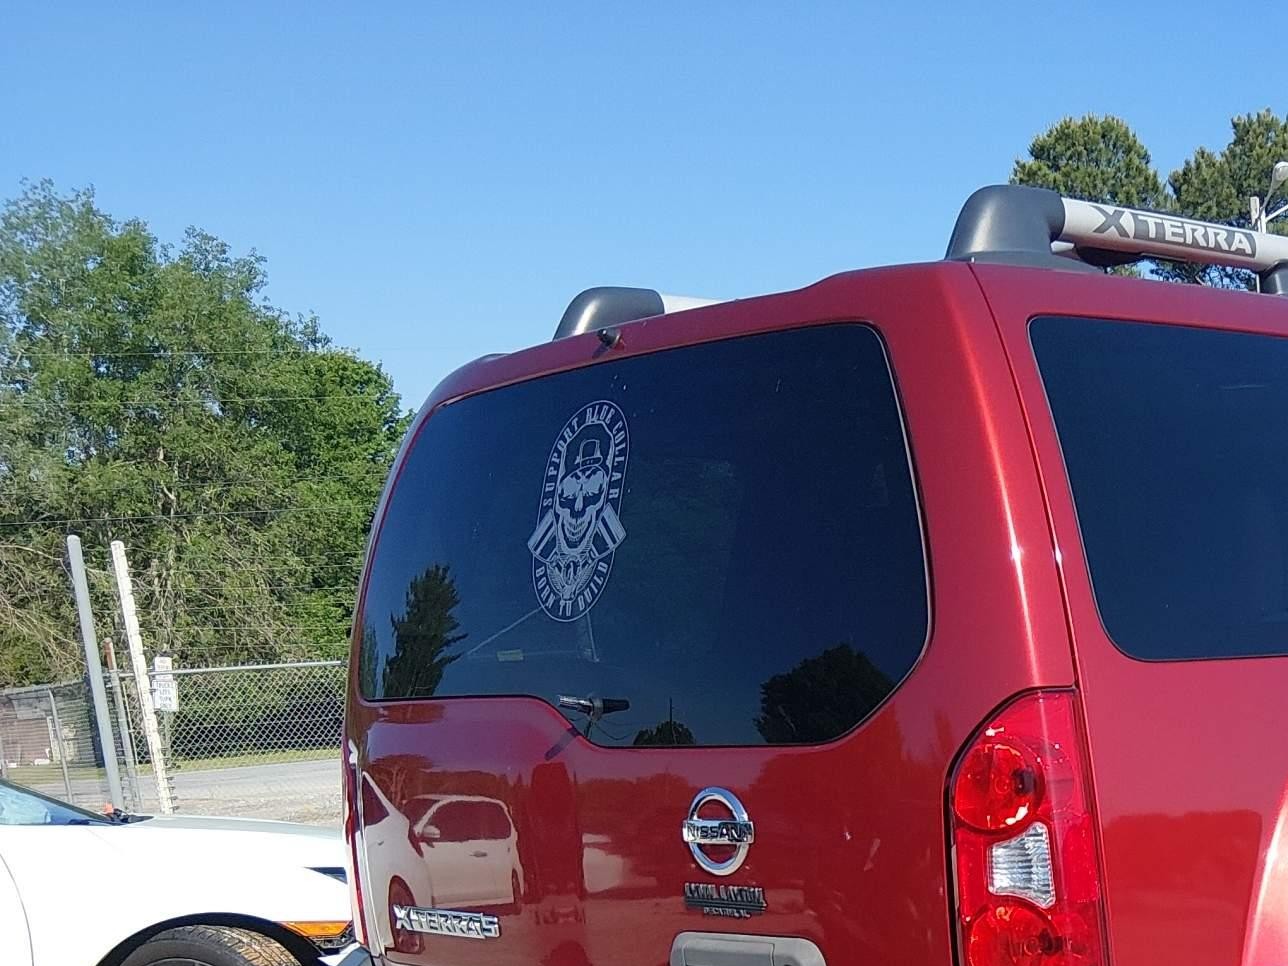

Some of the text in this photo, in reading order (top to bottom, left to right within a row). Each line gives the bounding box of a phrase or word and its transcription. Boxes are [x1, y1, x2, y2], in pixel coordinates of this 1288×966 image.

[1088, 204, 1254, 255] XTERRA
[543, 405, 626, 507] SUPPORT BLUE COLLAR
[536, 561, 608, 616] BORN TO BUILD
[687, 822, 743, 842] NISSAN
[393, 904, 484, 938] XTERRA
